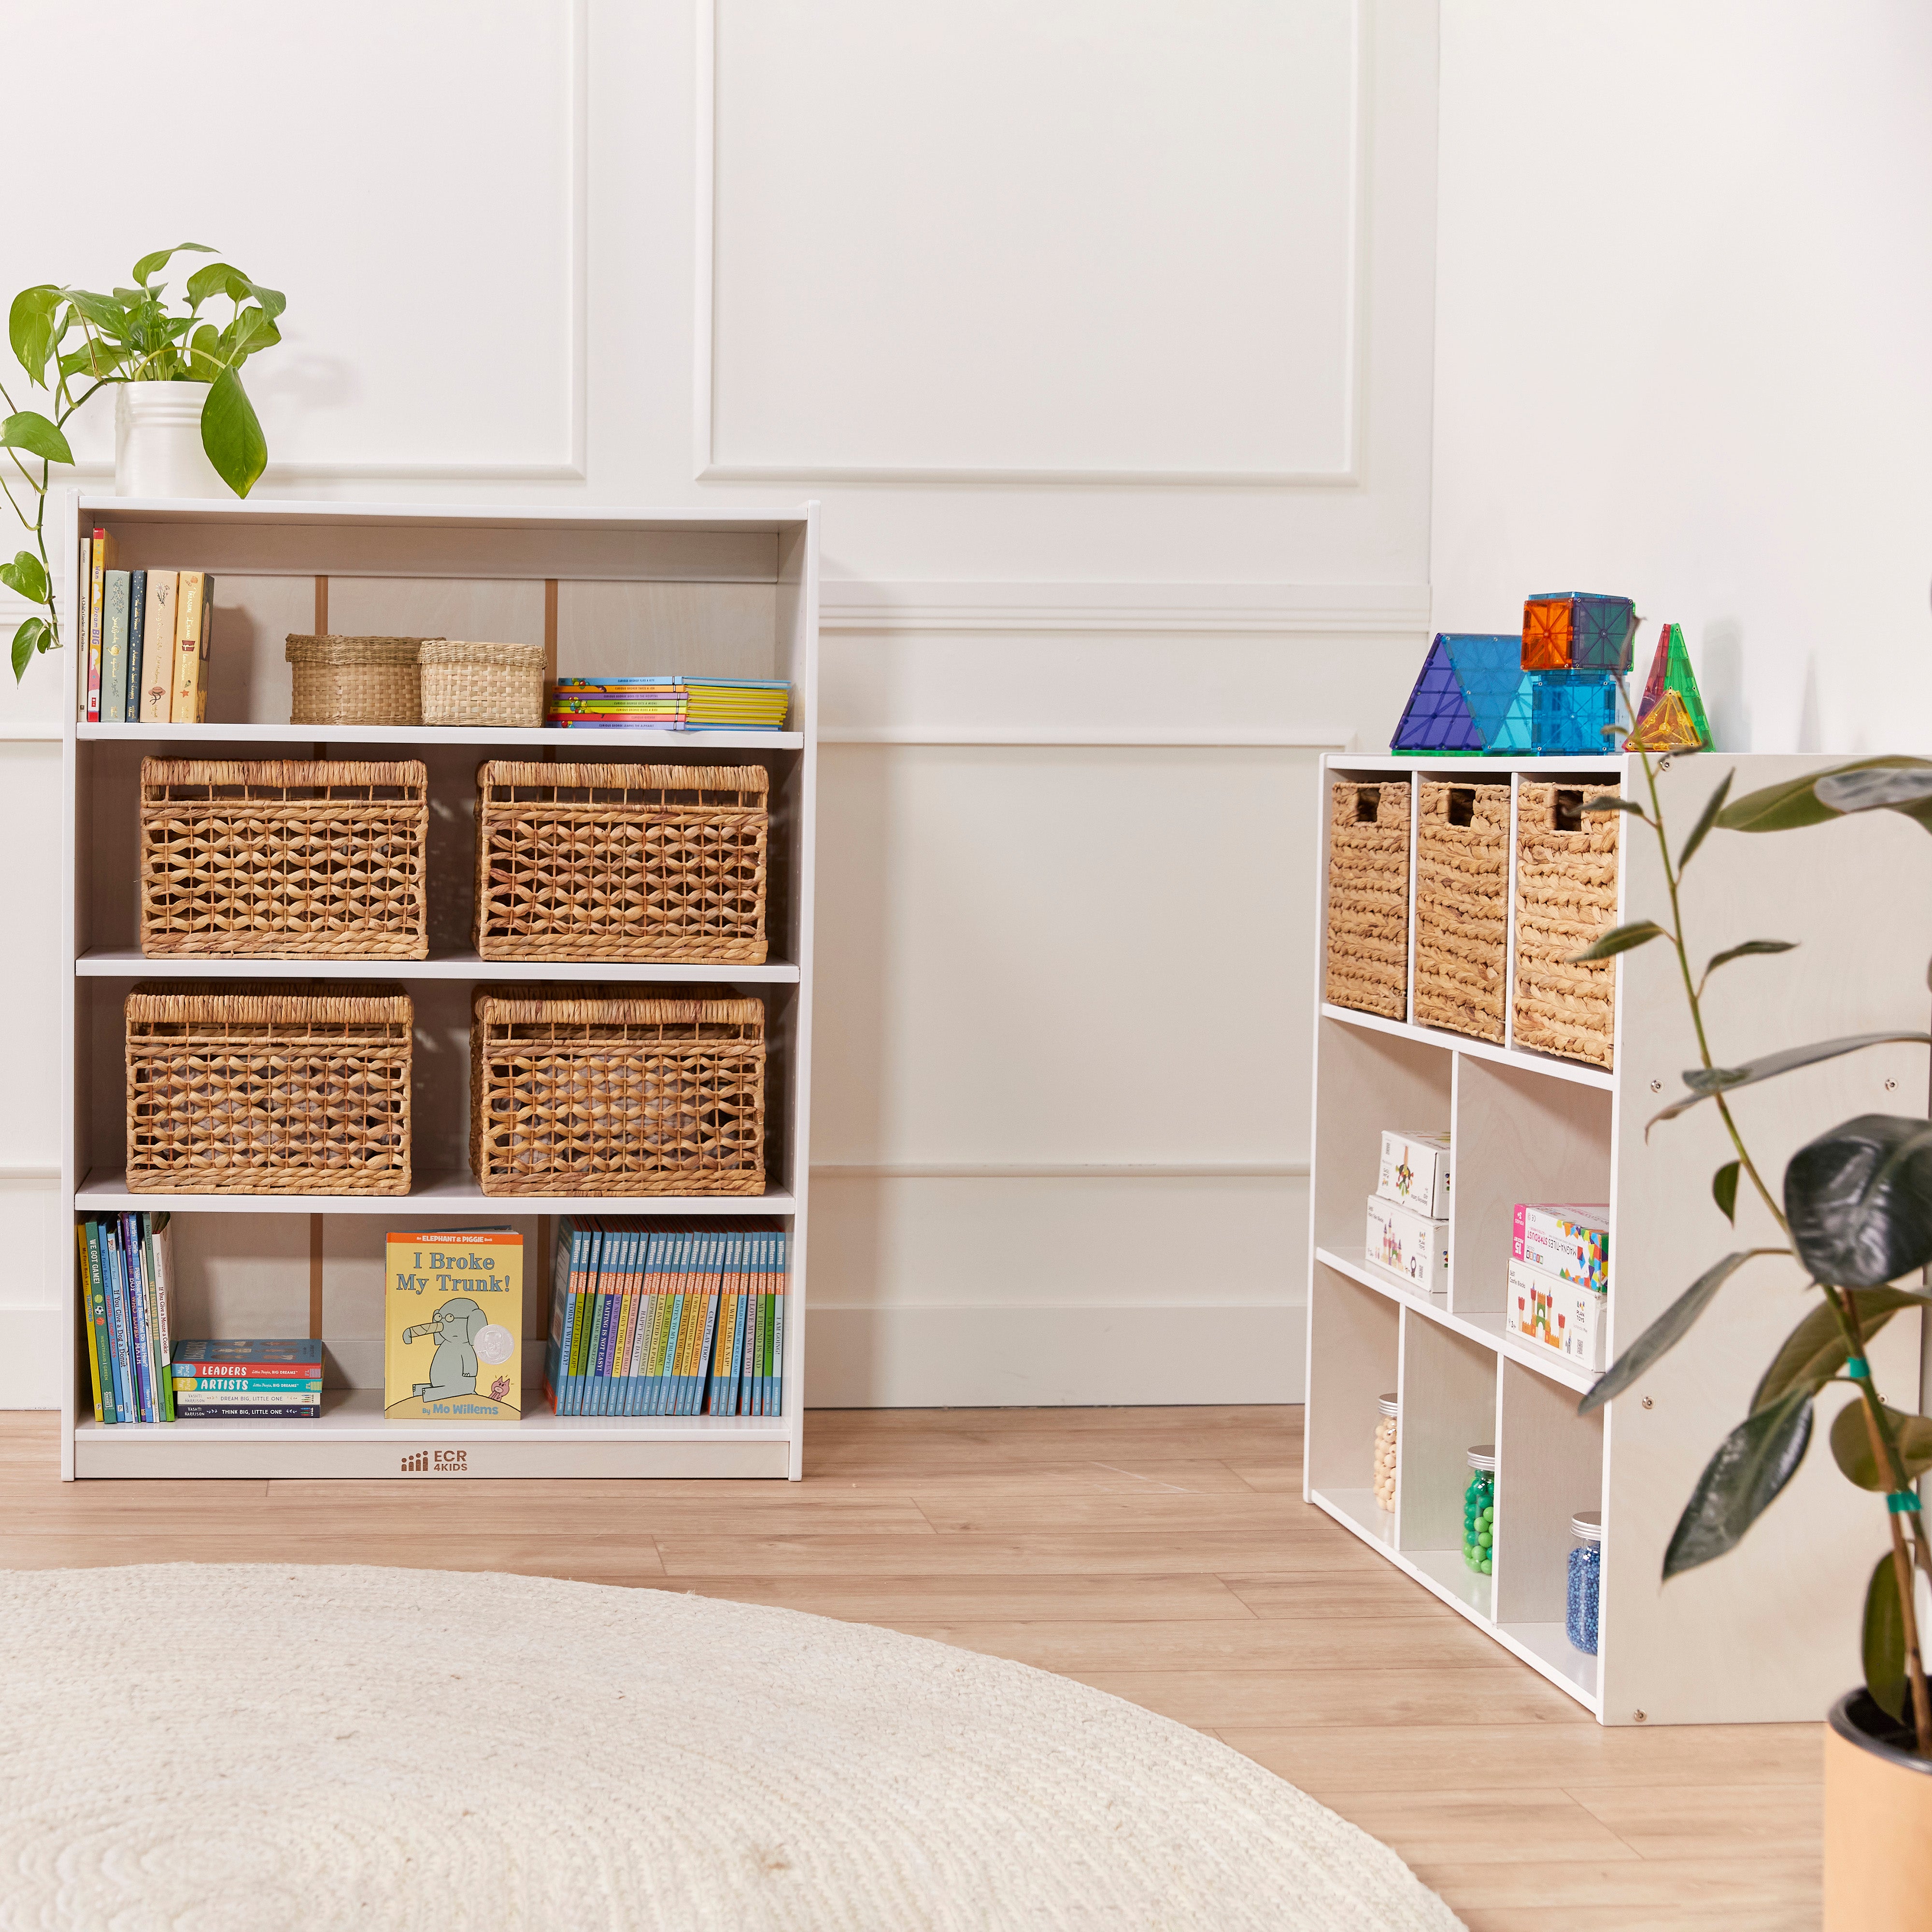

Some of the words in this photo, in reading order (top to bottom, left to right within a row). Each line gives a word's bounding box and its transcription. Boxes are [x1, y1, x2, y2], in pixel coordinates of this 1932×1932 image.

[90, 1239, 96, 1249] WE
[638, 1241, 646, 1264] Willems
[648, 1242, 656, 1265] Willems
[656, 1240, 665, 1264] Willems
[665, 1241, 673, 1265] Willems
[674, 1241, 682, 1264] Willems
[682, 1241, 690, 1264] Willems
[691, 1240, 700, 1264] Willems
[699, 1241, 708, 1264] Willems
[708, 1241, 717, 1264] Willems
[716, 1242, 724, 1265] Willems
[1515, 1242, 1521, 1255] 15
[413, 1252, 422, 1269] I
[429, 1252, 495, 1270] Broke
[397, 1274, 429, 1295] My
[436, 1274, 510, 1292] Trunk!
[603, 1300, 611, 1327] WAITING
[758, 1304, 764, 1313] MY
[669, 1332, 675, 1340] MY
[776, 1321, 781, 1331] AM
[665, 1342, 674, 1371] TRUMPET!
[202, 1366, 247, 1376] LEADERS
[201, 1379, 248, 1390] ARTISTS
[433, 1404, 450, 1414] Mo
[453, 1404, 498, 1415] Willems
[433, 1463, 468, 1471] 4KIDS
[434, 1450, 468, 1462] ECR
